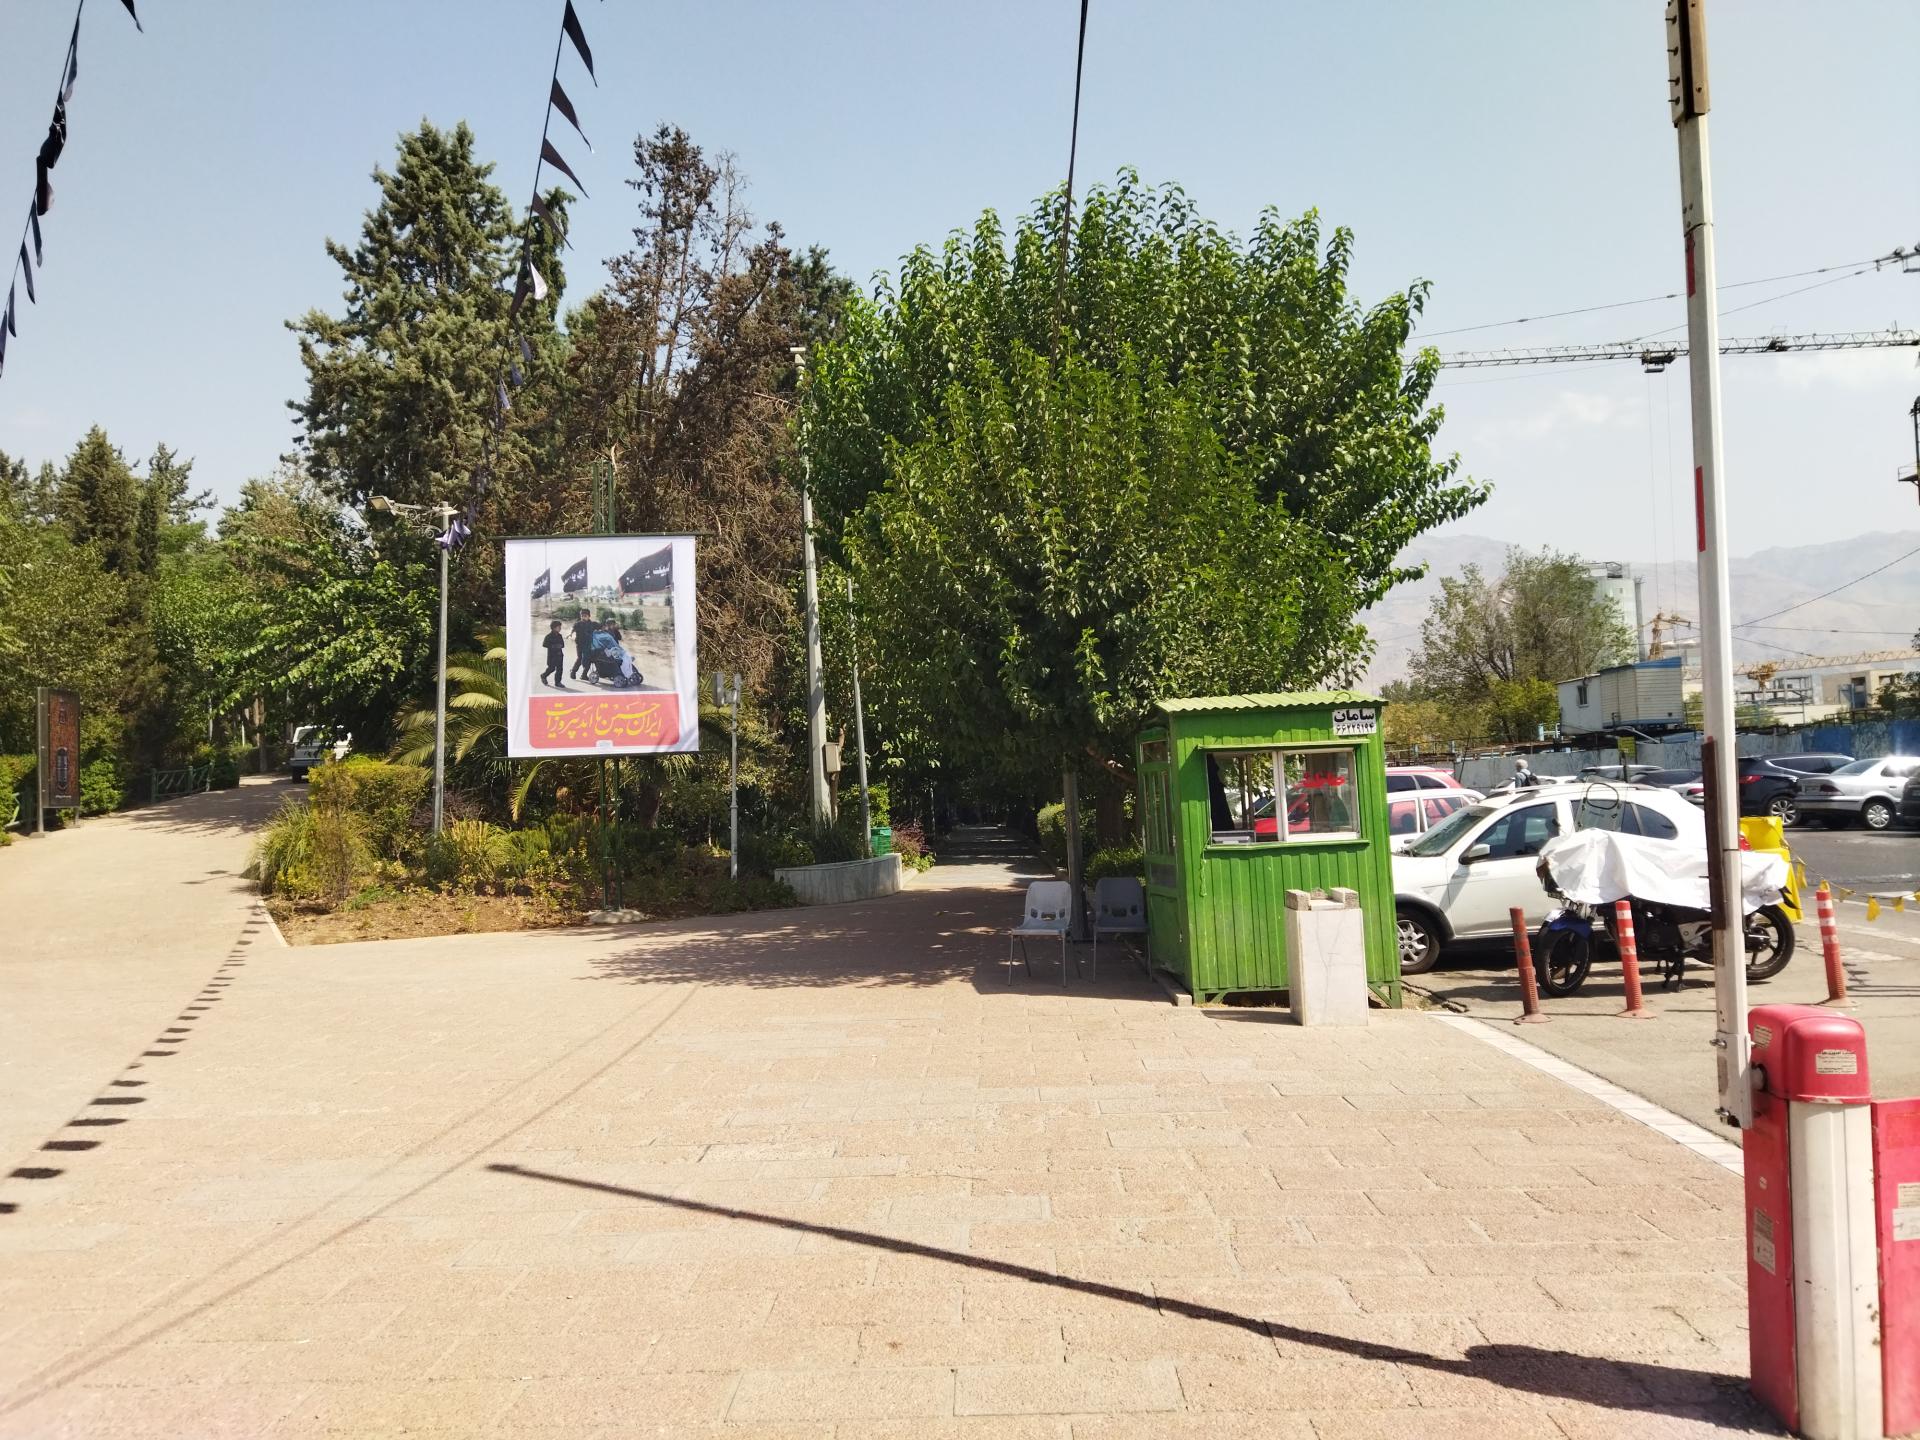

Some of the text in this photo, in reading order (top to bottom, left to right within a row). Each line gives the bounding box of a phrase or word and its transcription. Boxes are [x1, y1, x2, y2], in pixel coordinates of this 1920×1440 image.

[547, 716, 579, 739] پیروز
[578, 705, 593, 737] ابد
[626, 710, 662, 737] ایران
[1334, 708, 1374, 723] سامان
